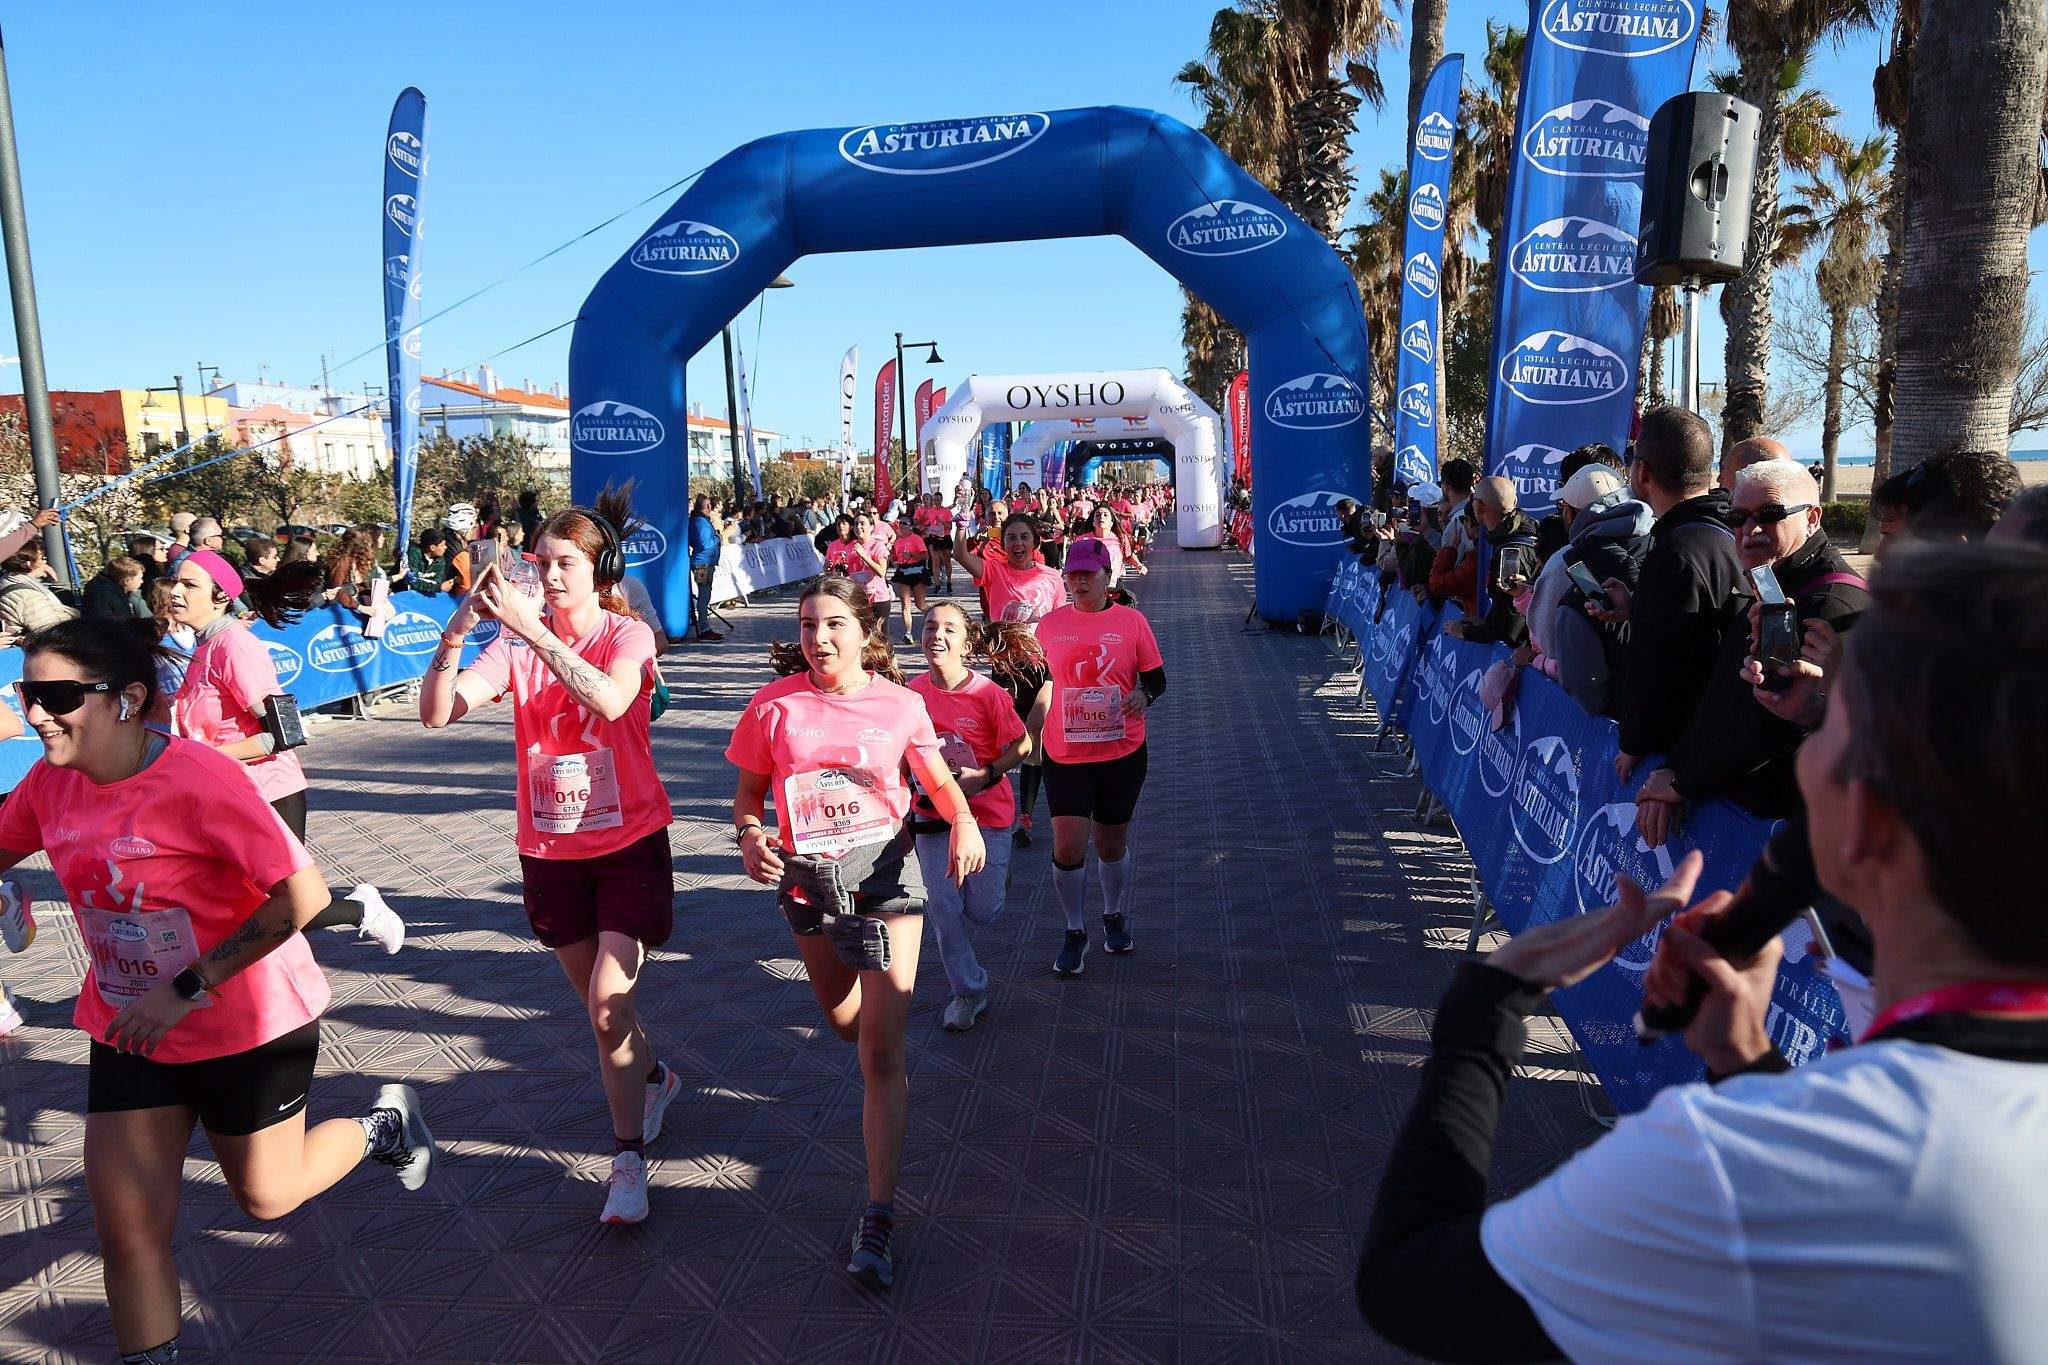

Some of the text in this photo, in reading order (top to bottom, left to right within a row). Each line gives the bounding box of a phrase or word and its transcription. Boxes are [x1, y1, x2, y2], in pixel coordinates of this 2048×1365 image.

[1577, 0, 1681, 14] CENTRAL LECHERA
[1550, 4, 1680, 39] ASTURIANA
[853, 120, 1034, 157] ASTURIANA
[1552, 125, 1649, 142] CENTRAL LECHER
[1533, 128, 1647, 165] ASTURIAN
[1177, 223, 1280, 246] ASTURIANA
[635, 244, 731, 263] ASTURIANA
[1535, 242, 1575, 250] CENTRAL
[1519, 244, 1634, 275] ASTURIANA
[1524, 354, 1613, 368] CENTRAL LECHERA
[1510, 355, 1615, 390] ASTURIANA
[1006, 381, 1125, 410] OYSHO
[1159, 404, 1197, 415] OYSHO
[1238, 389, 1248, 444] Santander
[1272, 397, 1361, 418] ASTURIANA
[938, 415, 973, 424] OYSHO
[573, 421, 658, 442] ASTURIANA
[1096, 441, 1154, 450] VOLVO
[1182, 504, 1216, 513] OYSHO
[1084, 711, 1107, 720] 016
[555, 788, 591, 804] 016
[824, 800, 860, 819] 016
[540, 821, 566, 829] OYSHO
[806, 838, 838, 848] OYSHO
[119, 958, 158, 976] 016
